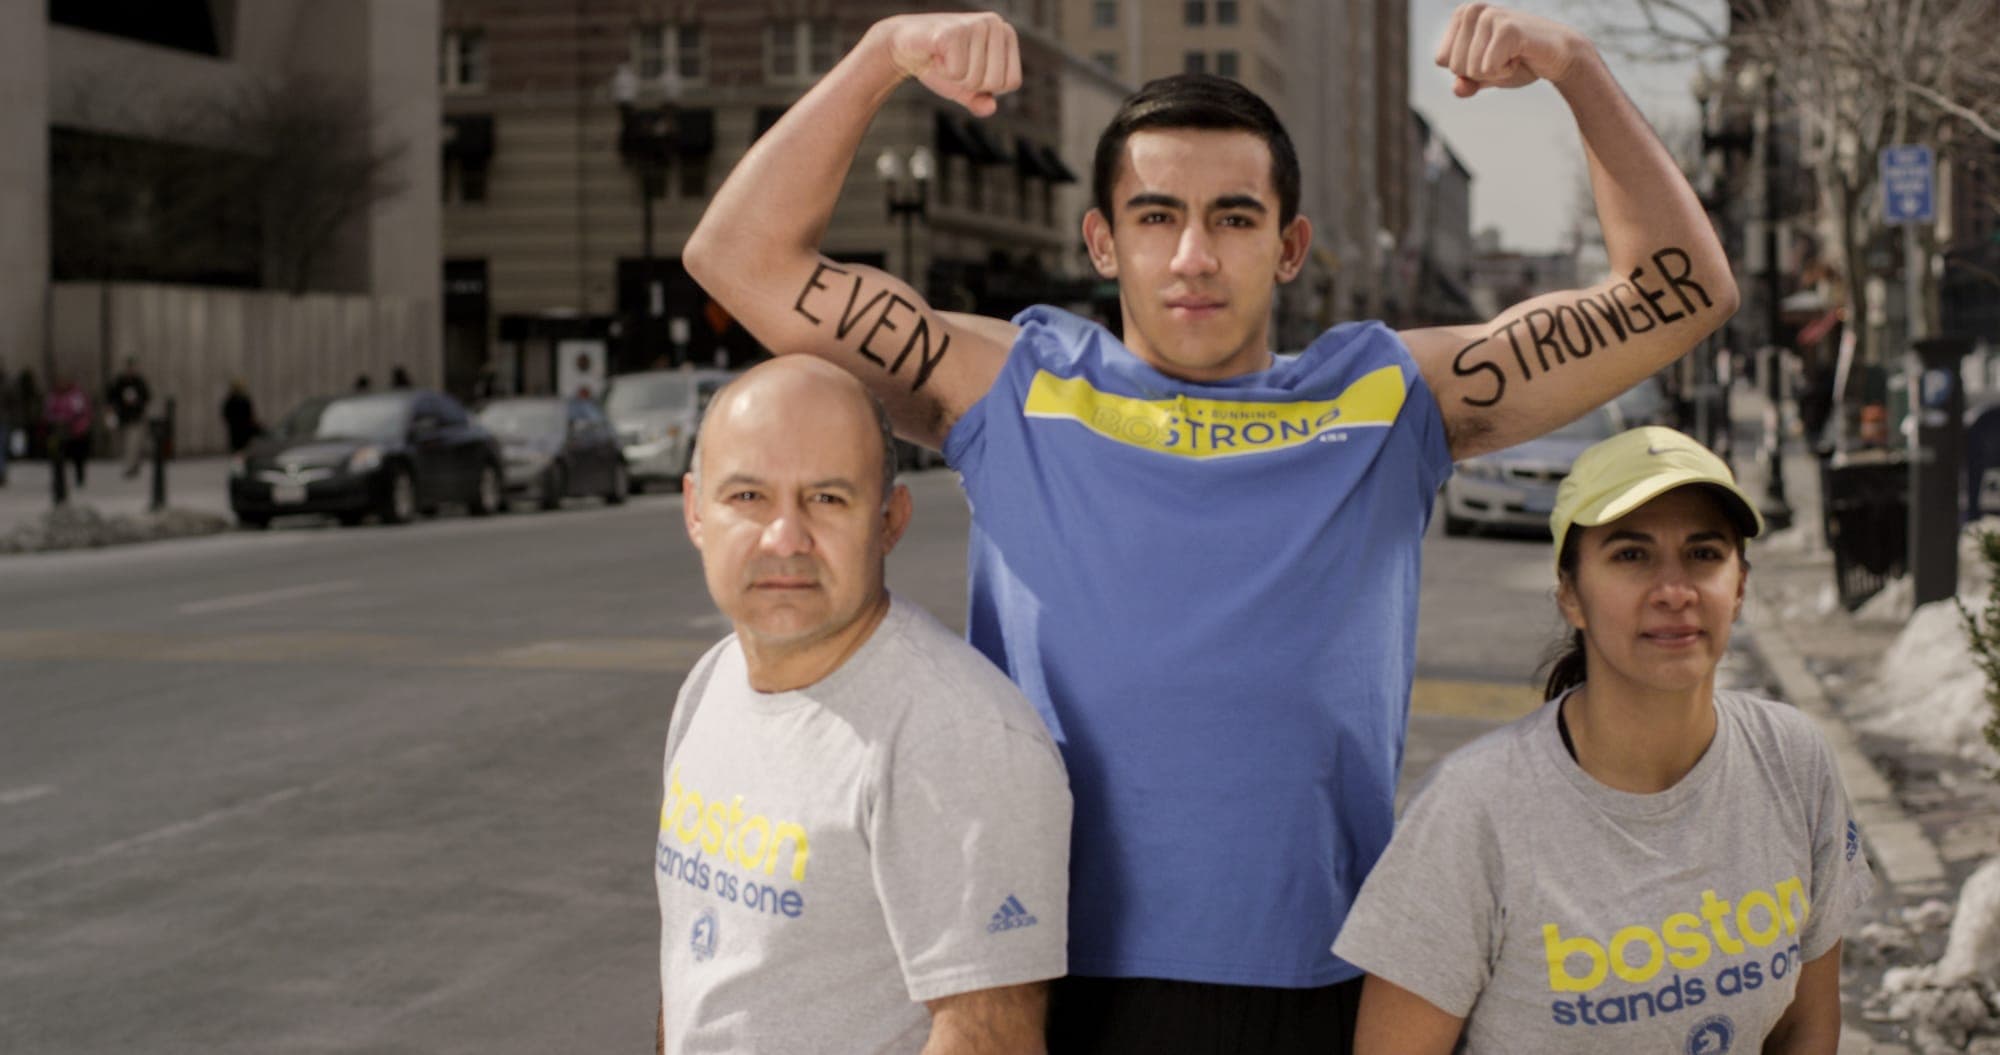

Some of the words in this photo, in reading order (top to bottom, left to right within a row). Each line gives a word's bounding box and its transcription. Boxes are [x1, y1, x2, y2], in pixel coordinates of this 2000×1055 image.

[794, 262, 950, 392] EVEN
[1452, 247, 1714, 407] STRONGER
[714, 869, 739, 903] as
[743, 882, 804, 918] one
[1542, 876, 1809, 992] boston
[1552, 974, 1707, 1026] stands
[1715, 960, 1764, 997] as
[1771, 944, 1800, 980] on
